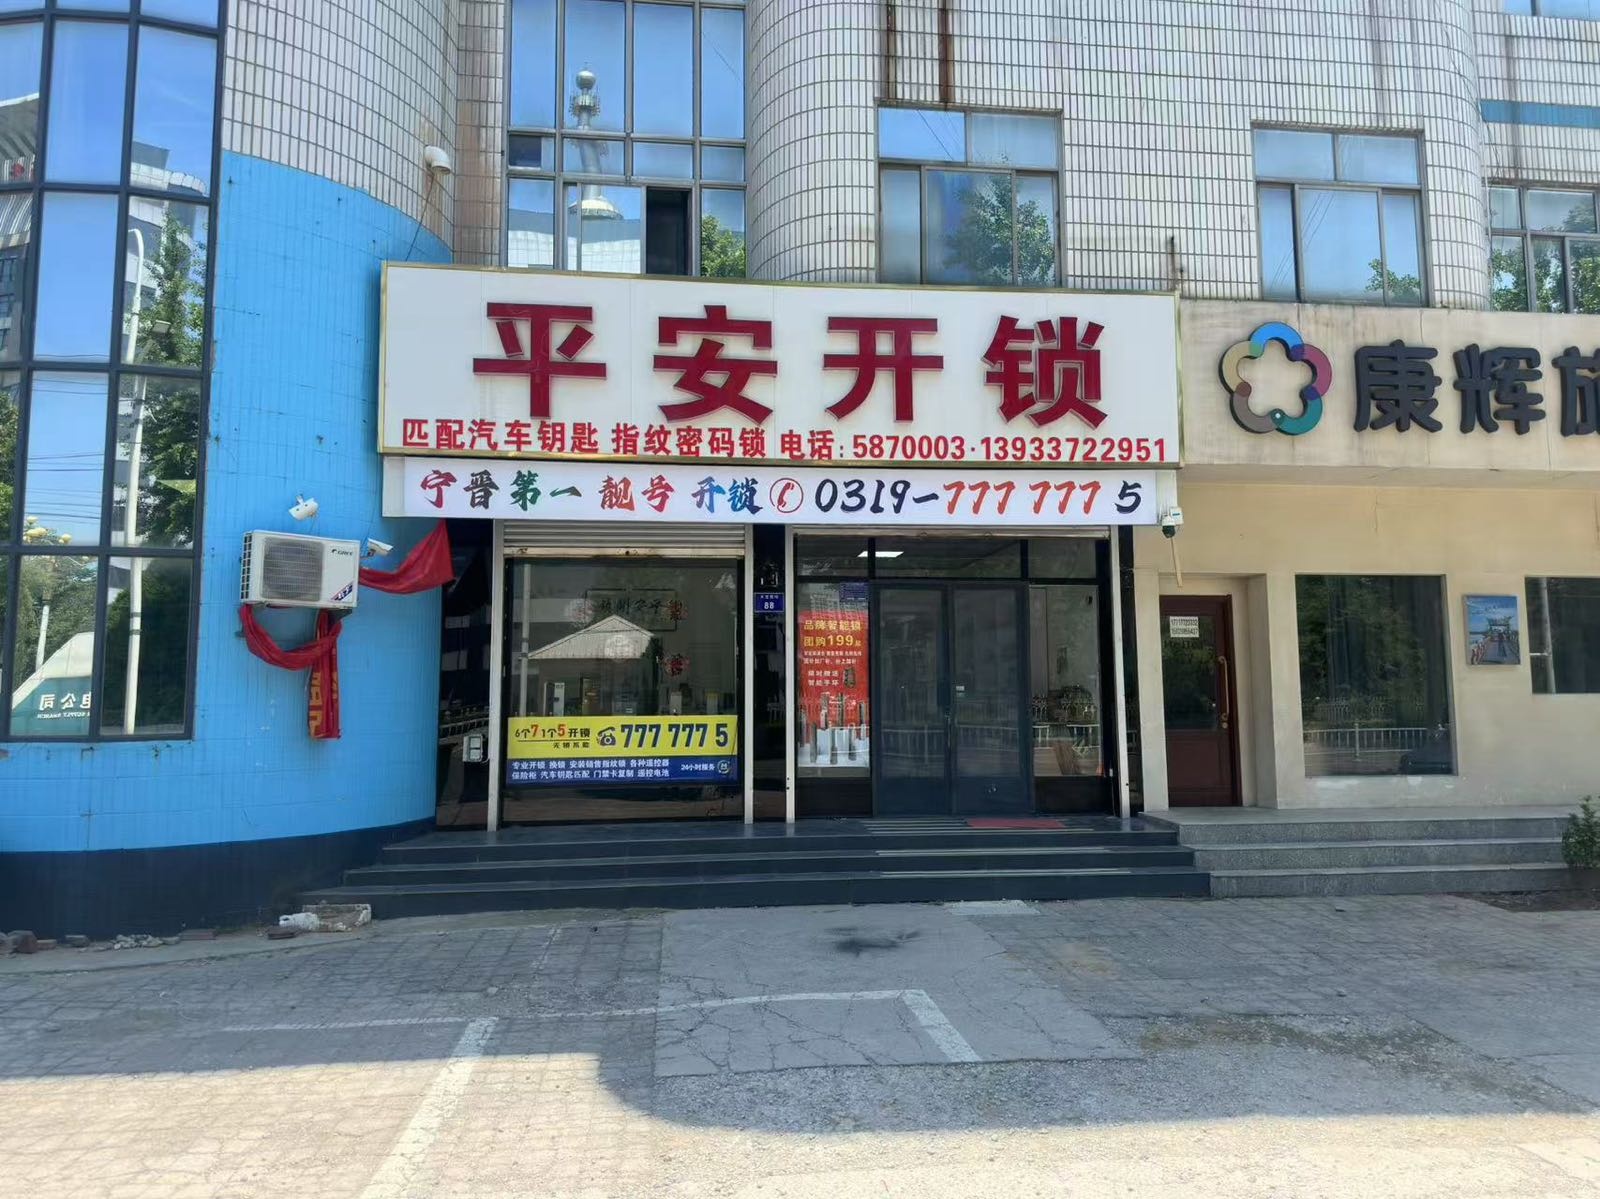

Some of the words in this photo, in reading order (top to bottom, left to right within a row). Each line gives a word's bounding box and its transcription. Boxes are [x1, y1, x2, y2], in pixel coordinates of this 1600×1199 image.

[472, 302, 1108, 430] 平安开锁
[403, 418, 599, 454] 匹配汽车钥匙
[611, 422, 766, 458] 指纹密码锁
[691, 476, 763, 515] 开锁
